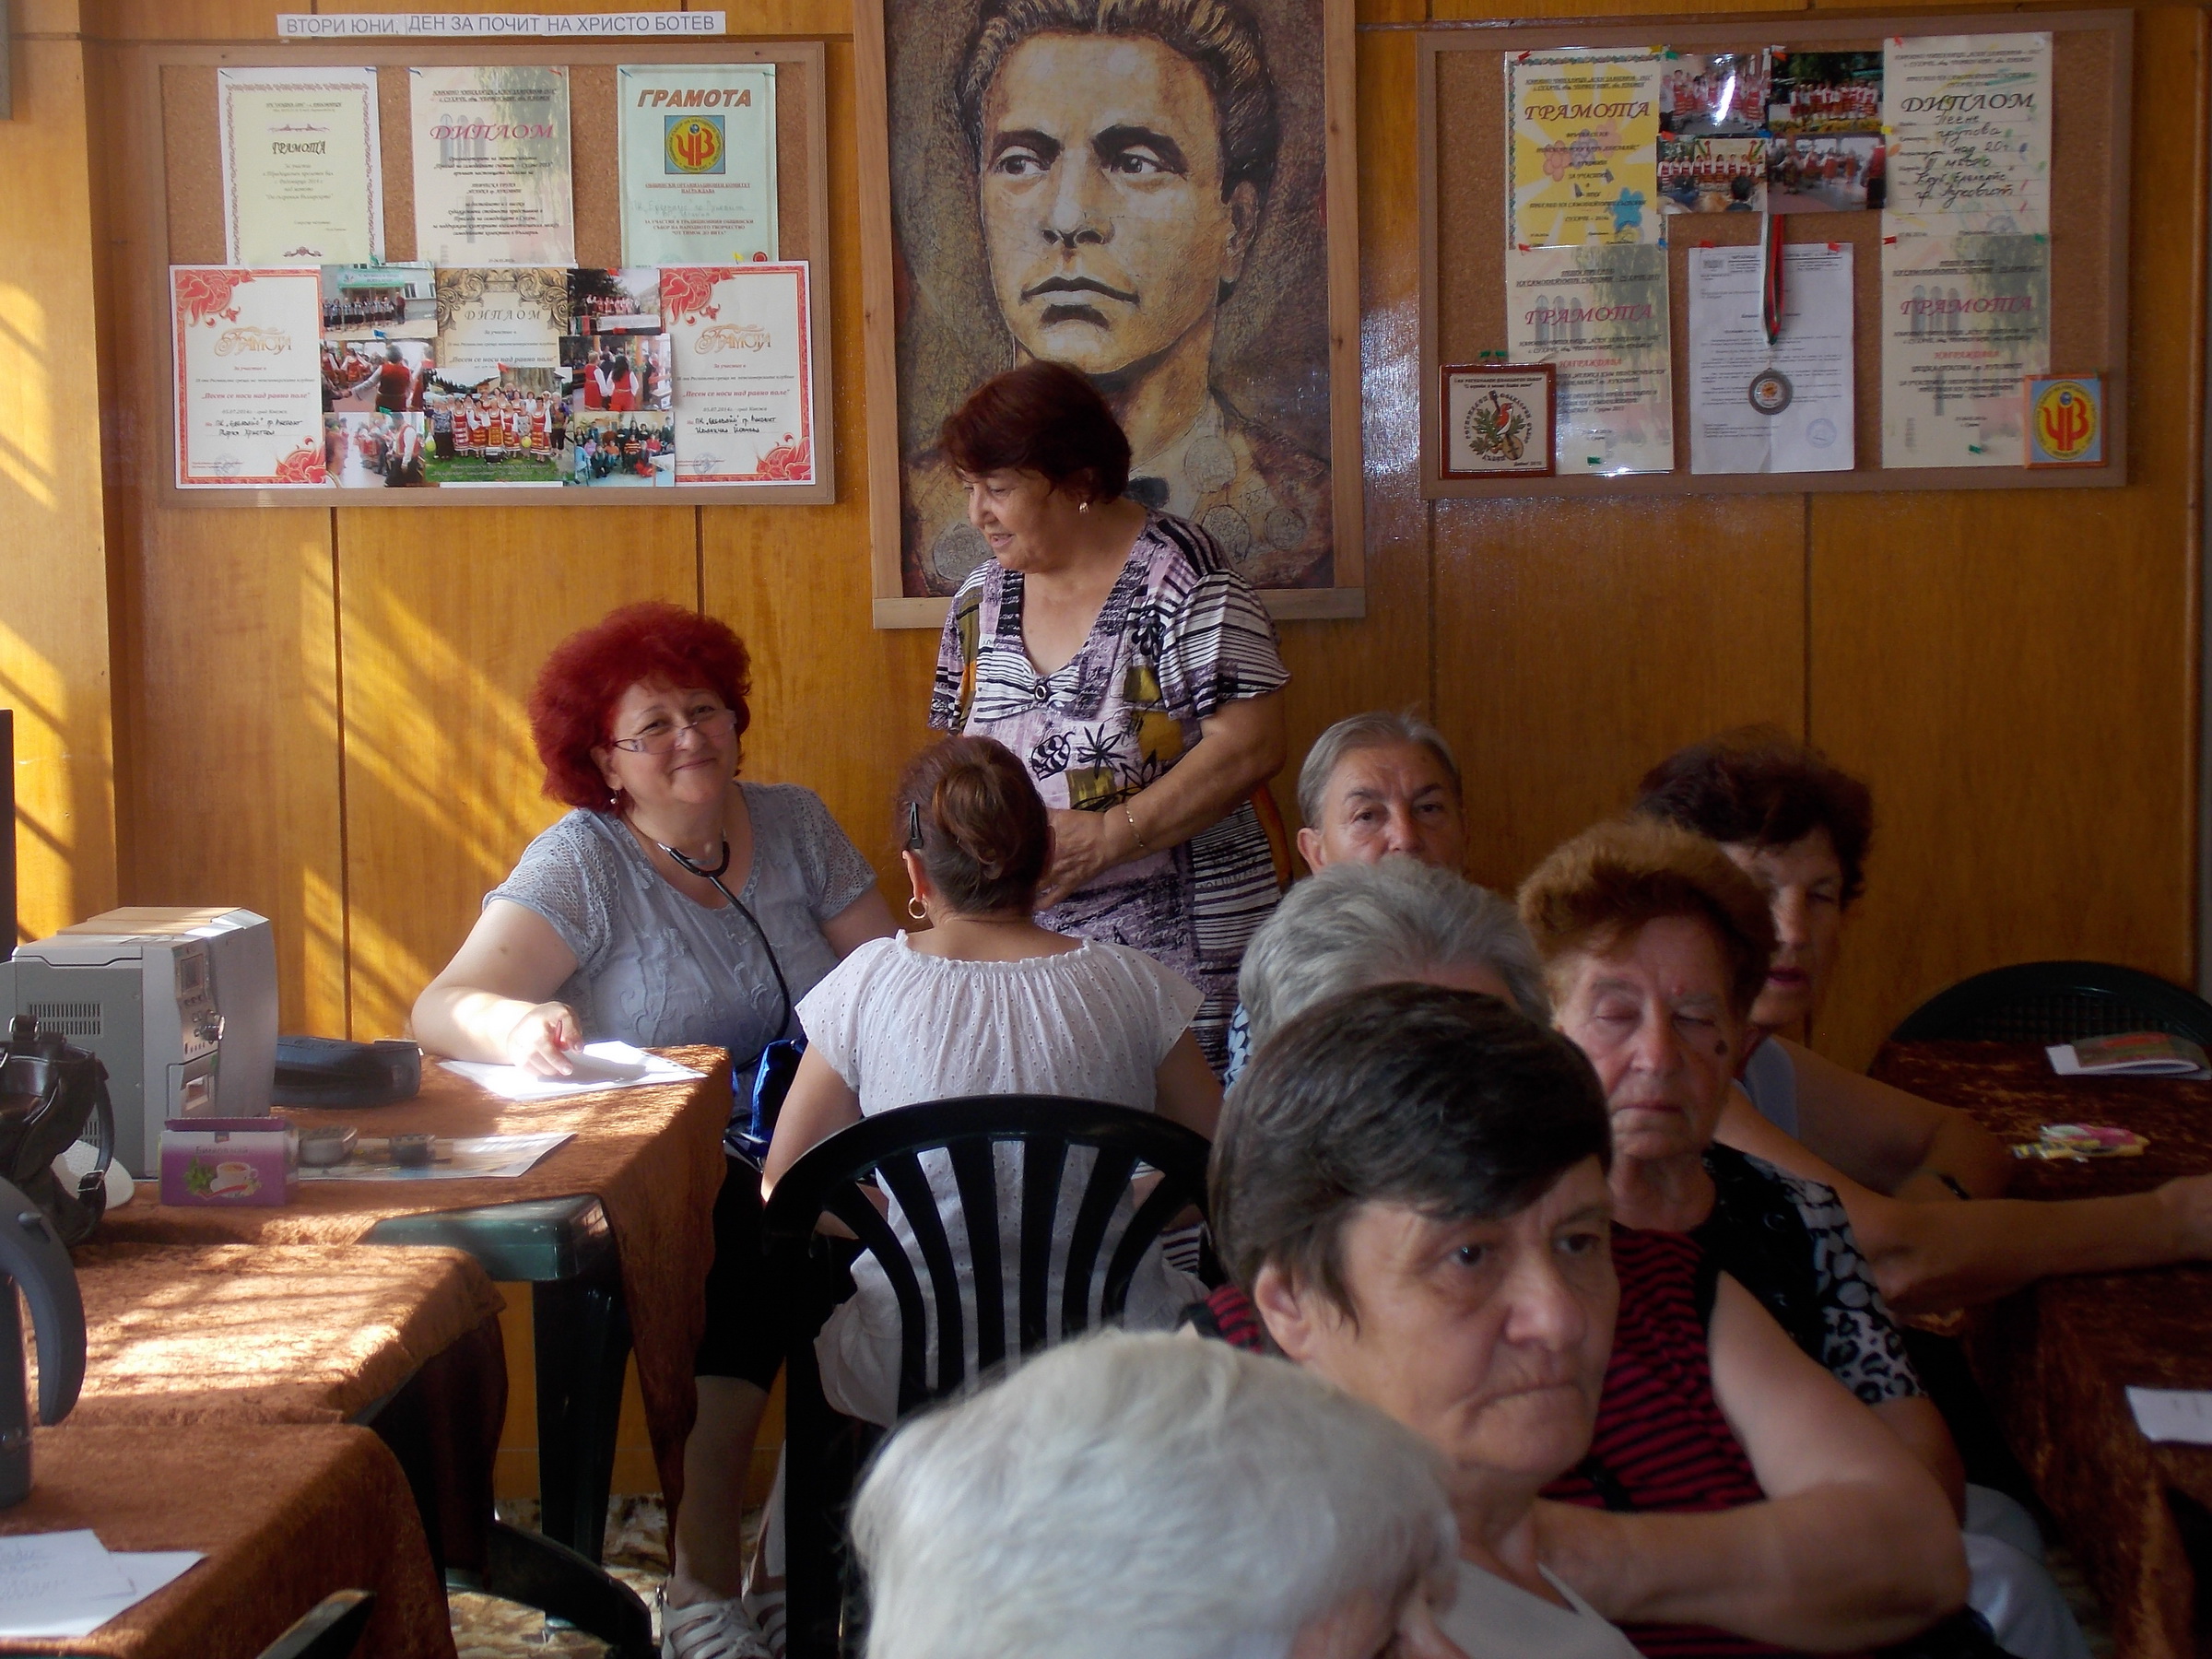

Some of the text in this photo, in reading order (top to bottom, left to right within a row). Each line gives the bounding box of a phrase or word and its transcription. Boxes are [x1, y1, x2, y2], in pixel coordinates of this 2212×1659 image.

[287, 16, 715, 35] ВТОРИ ЮНИ, ДЕН ЗА ПОЧИТ НА ХРИСТО БОТЕВ
[638, 88, 752, 108] ГРАМОТА
[1900, 92, 2035, 112] ДИПЛОМ
[1524, 101, 1651, 121] ГРАМОТА
[429, 124, 554, 141] ДИПЛОМ
[272, 140, 326, 155] ГРАМОТА
[465, 310, 540, 322] ДИПЛОМ
[1524, 303, 1653, 326] ГРАМОТА
[1900, 296, 2032, 316] ГРАМОТА
